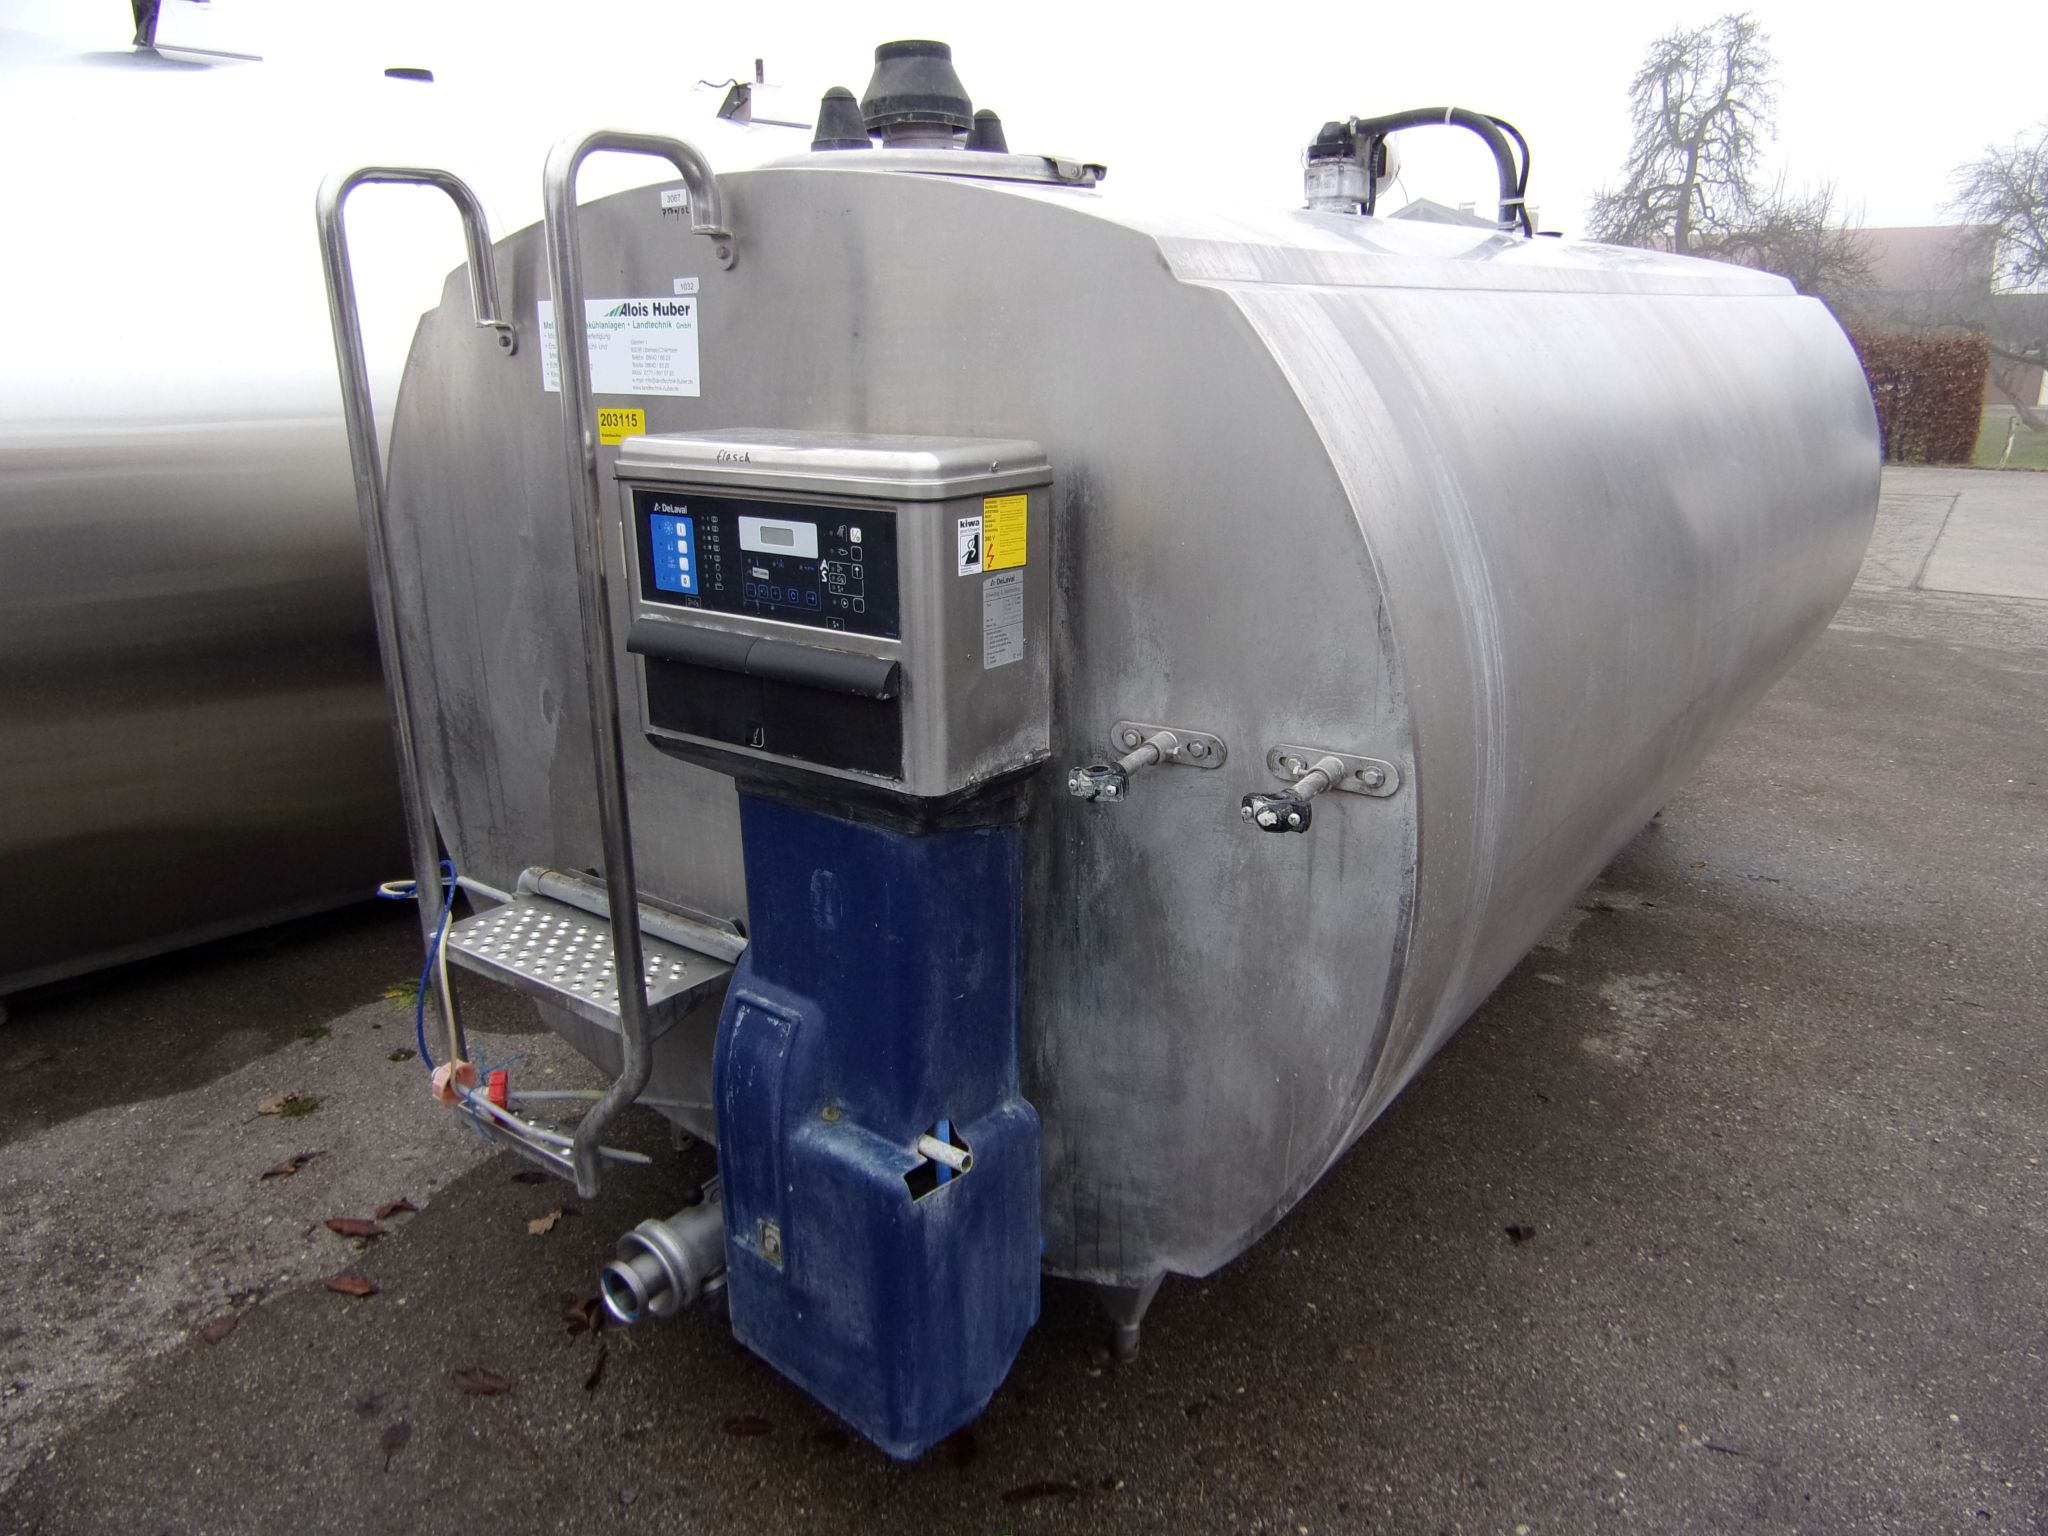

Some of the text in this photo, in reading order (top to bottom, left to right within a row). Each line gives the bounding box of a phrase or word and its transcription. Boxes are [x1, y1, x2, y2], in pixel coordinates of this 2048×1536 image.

[619, 301, 690, 317] Alois Huber
[632, 320, 673, 329] Landtechnik
[600, 413, 638, 427] 203115
[662, 503, 688, 514] DeLaval
[960, 518, 980, 529] kiwa
[996, 575, 1015, 585] DeLaval
